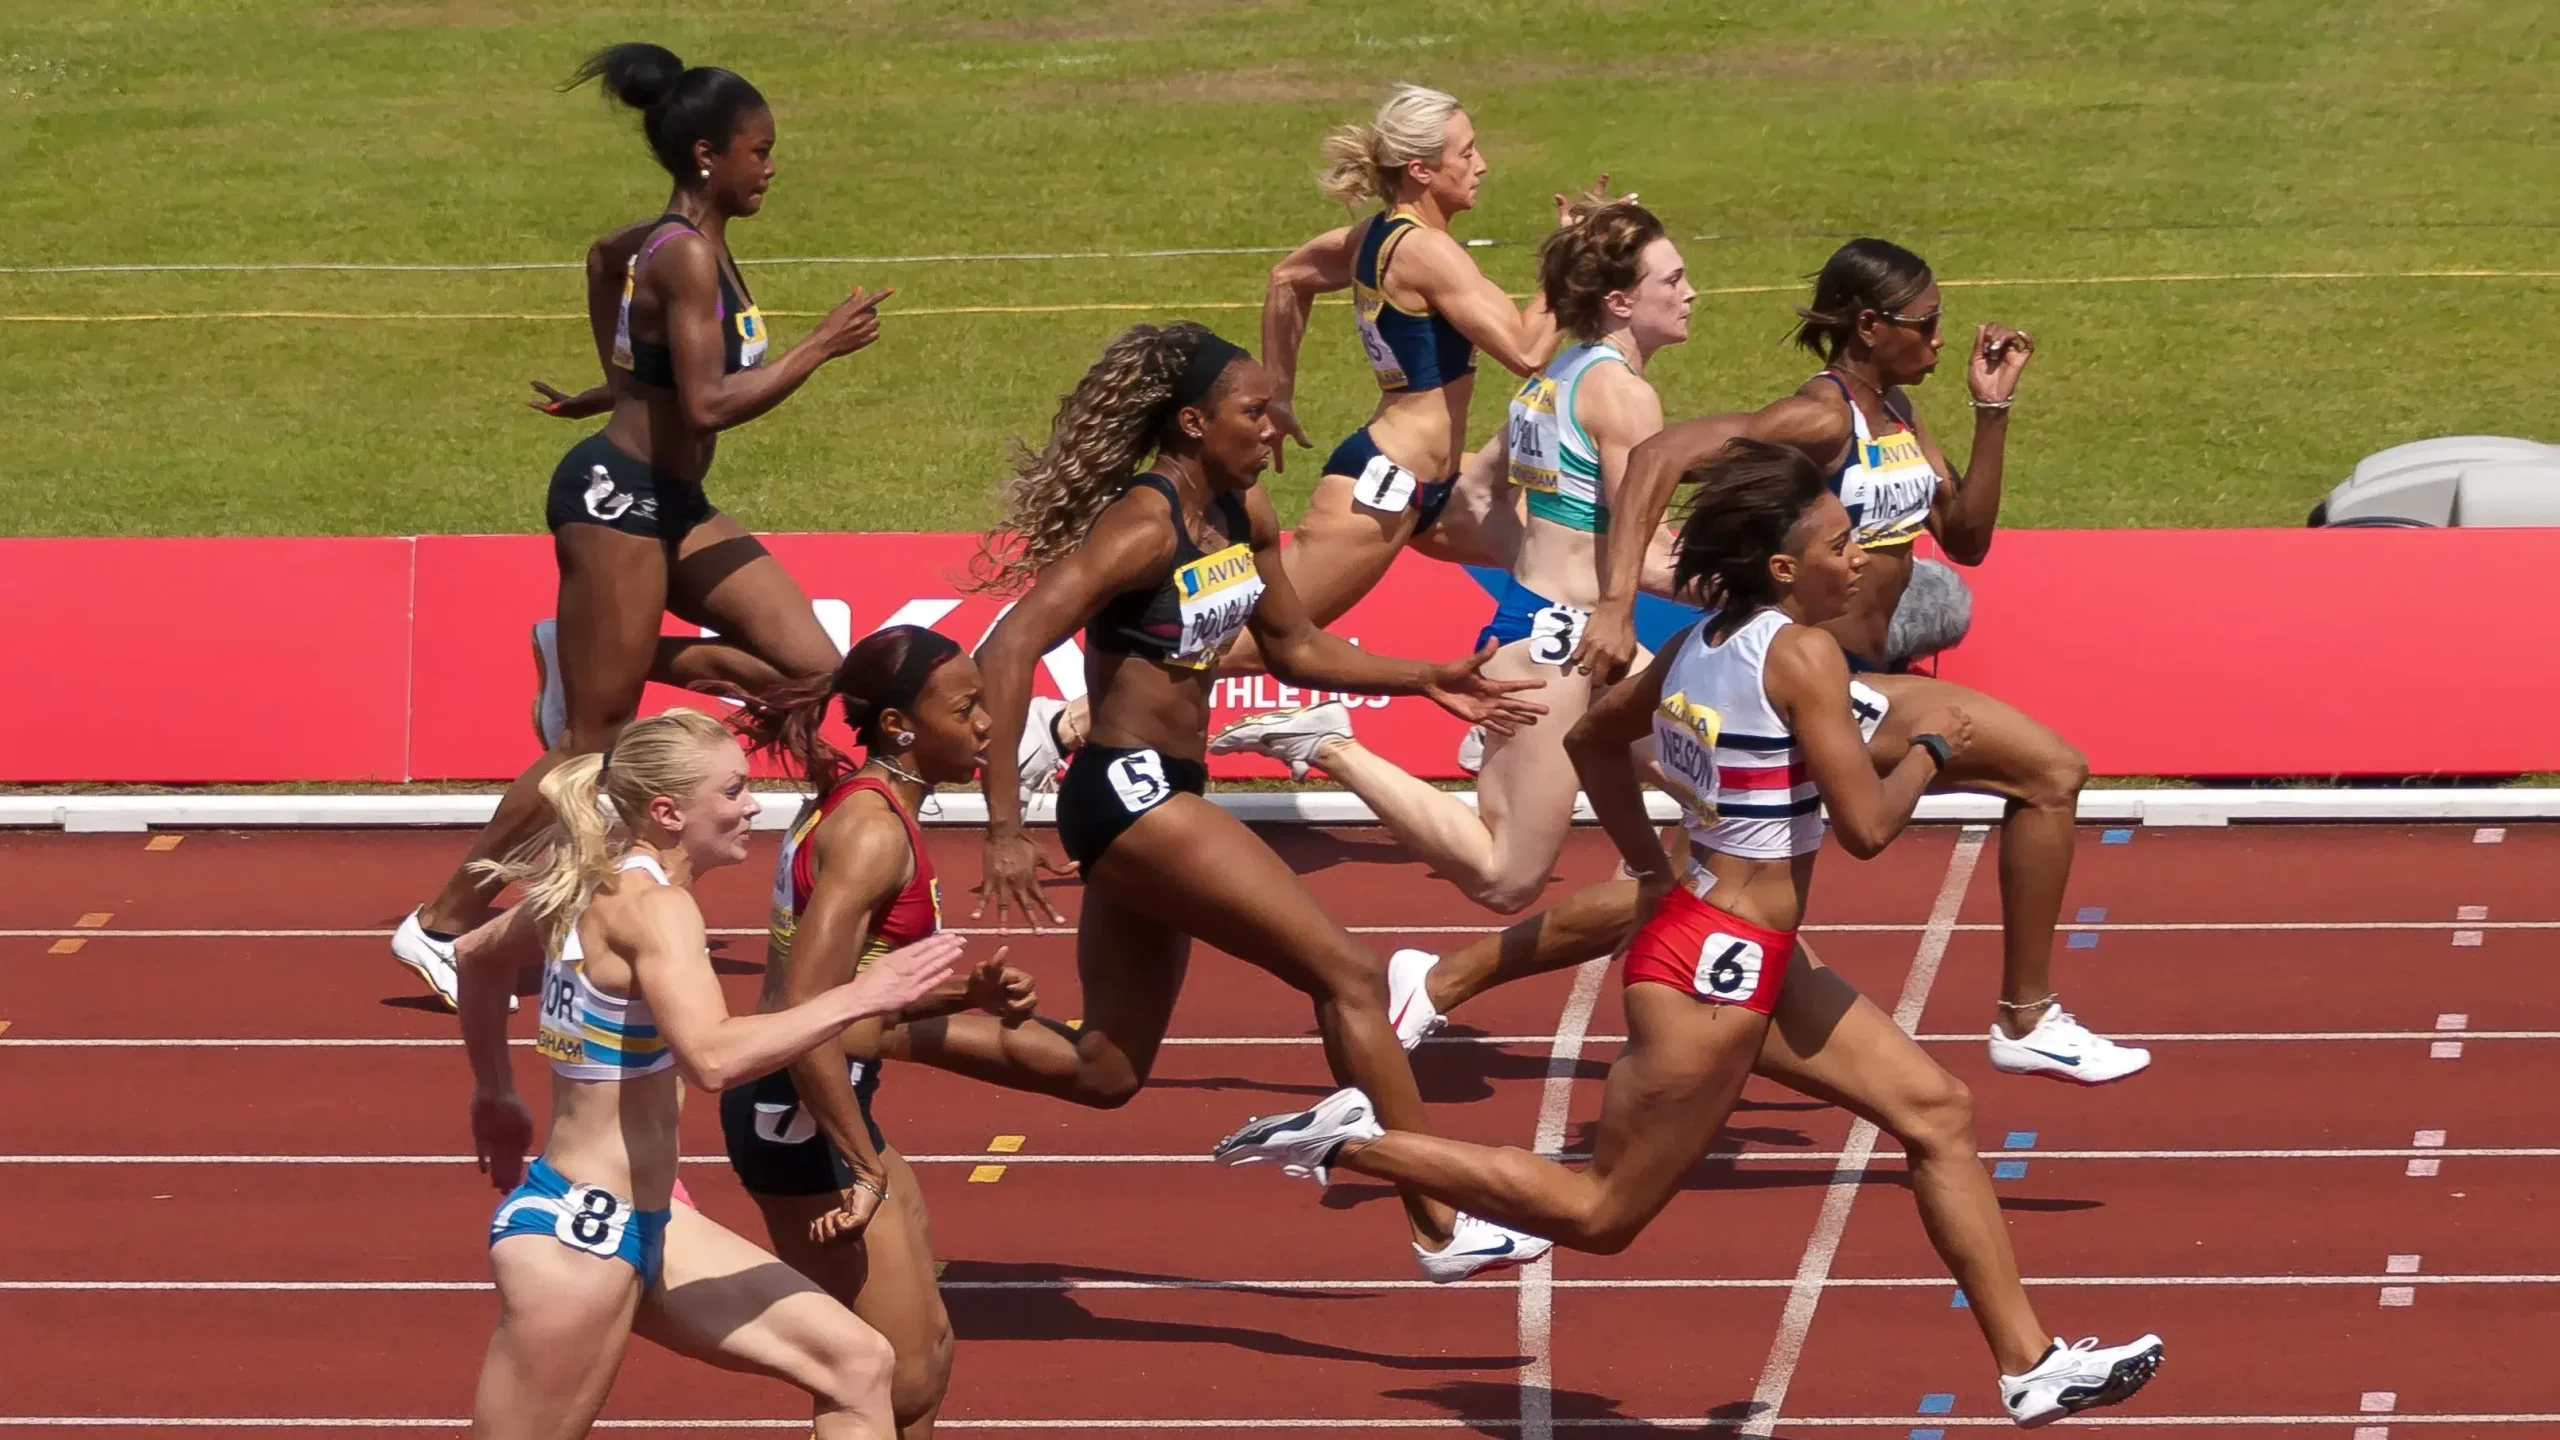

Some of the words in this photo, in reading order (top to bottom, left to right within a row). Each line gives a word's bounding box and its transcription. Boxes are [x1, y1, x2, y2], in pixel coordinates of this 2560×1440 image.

[1372, 465, 1400, 505] 1
[1541, 612, 1575, 661] 3
[1126, 753, 1159, 805] 5
[1660, 727, 1714, 791] NELSON
[1709, 941, 1748, 993] 6
[571, 1188, 617, 1246] 8
